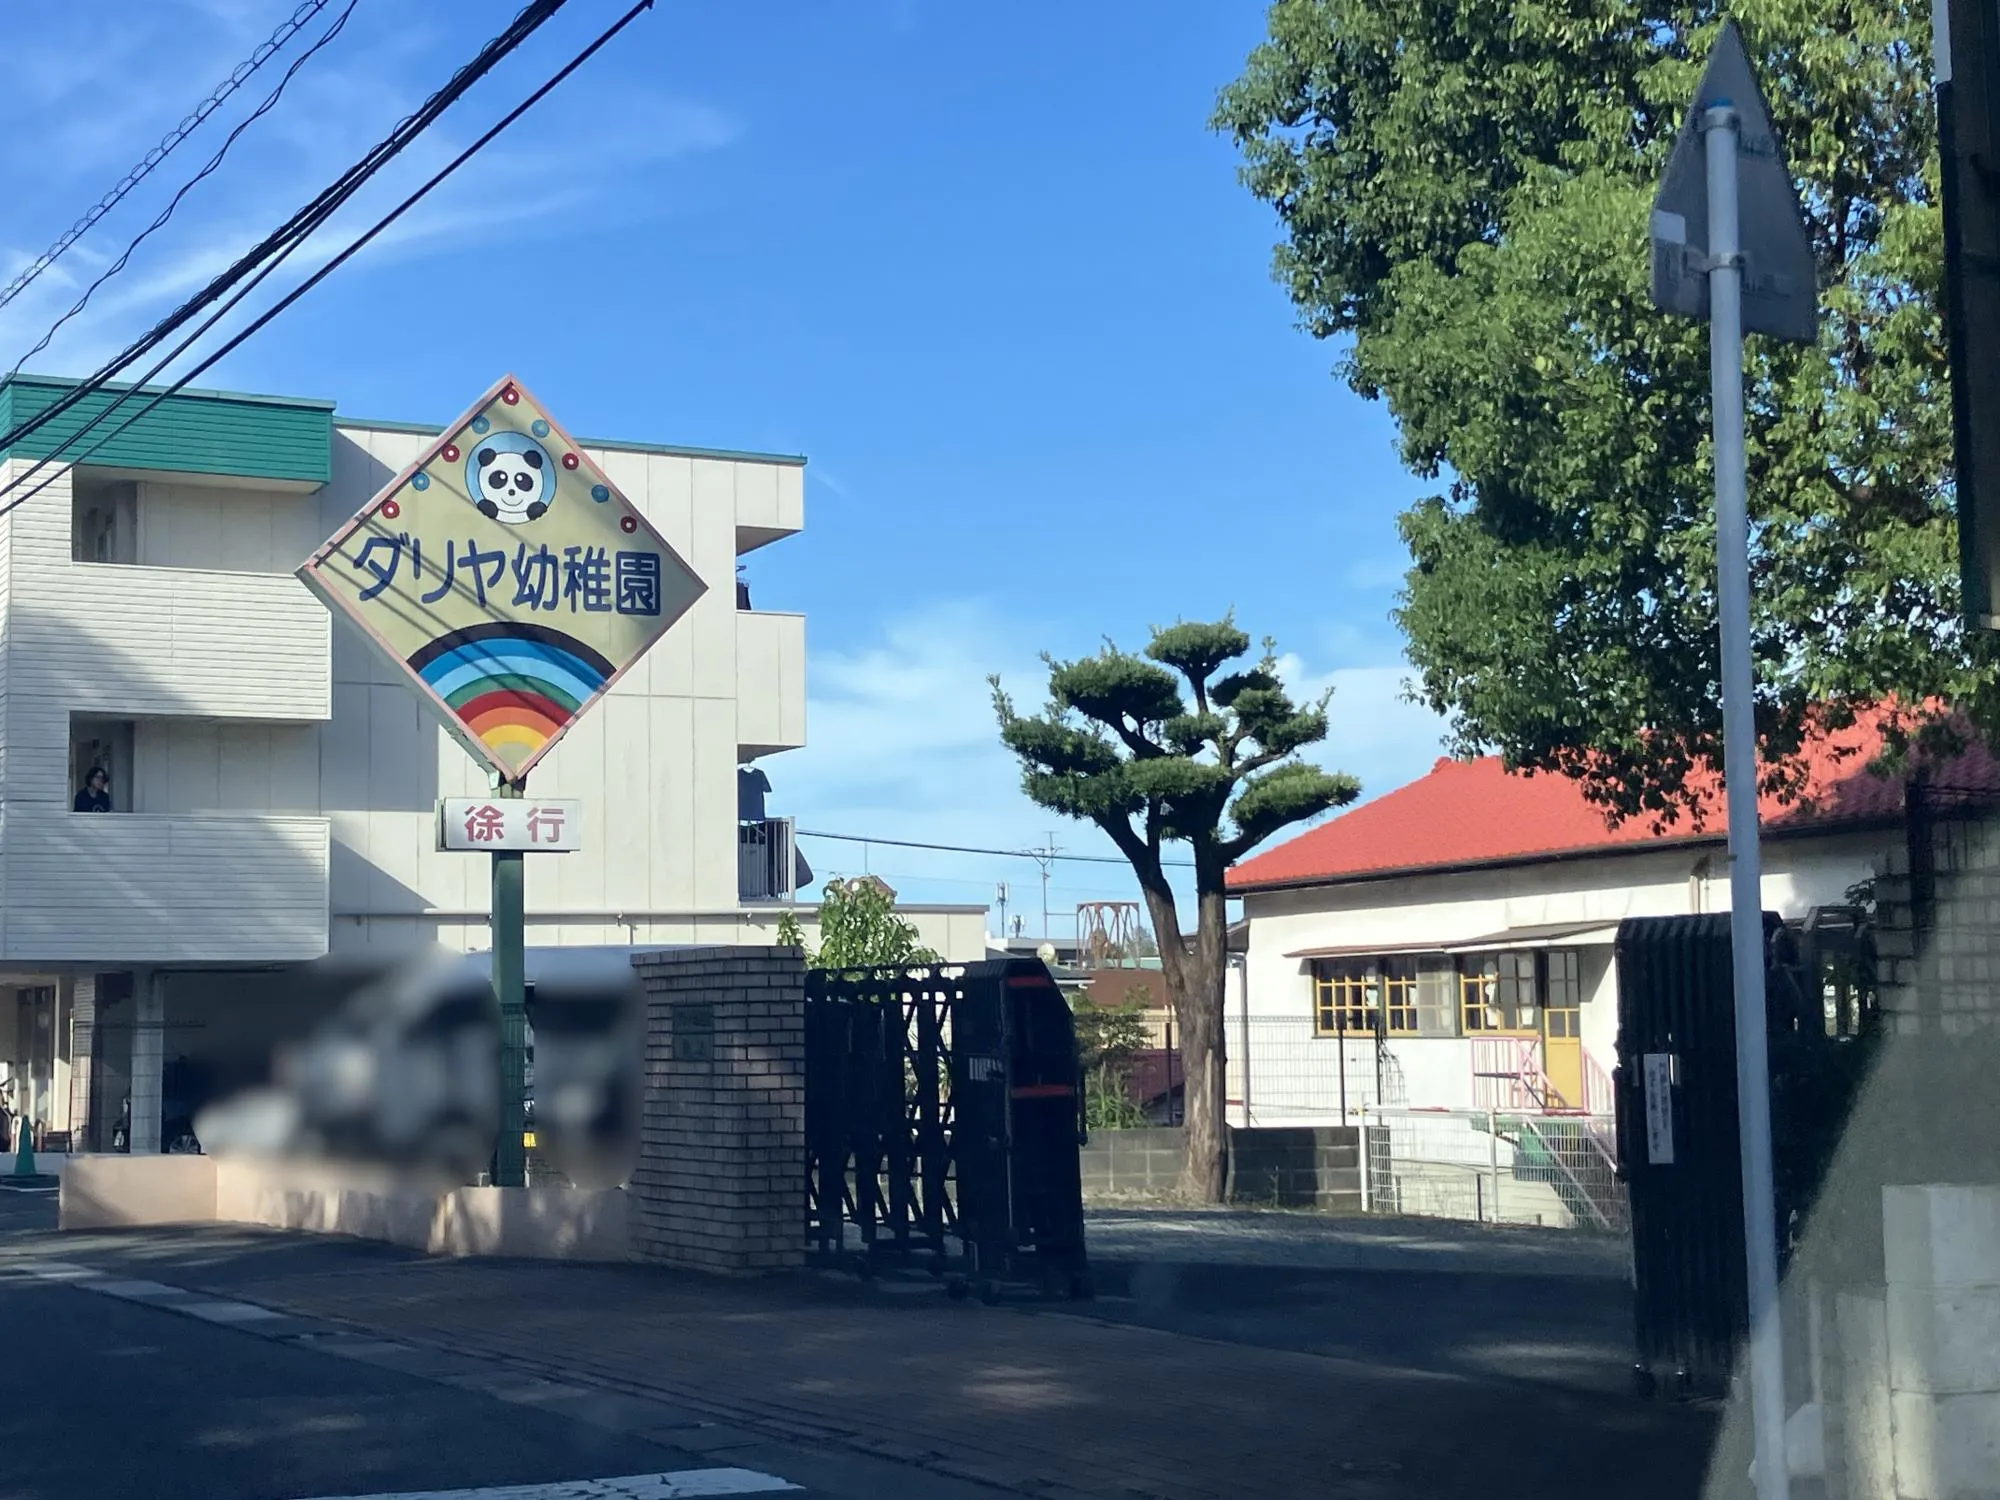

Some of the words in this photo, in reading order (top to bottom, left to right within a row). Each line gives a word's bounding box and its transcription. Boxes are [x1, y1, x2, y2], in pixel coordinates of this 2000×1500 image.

[353, 532, 661, 616] ダリヤ幼稚園
[464, 804, 565, 842] 徐行
